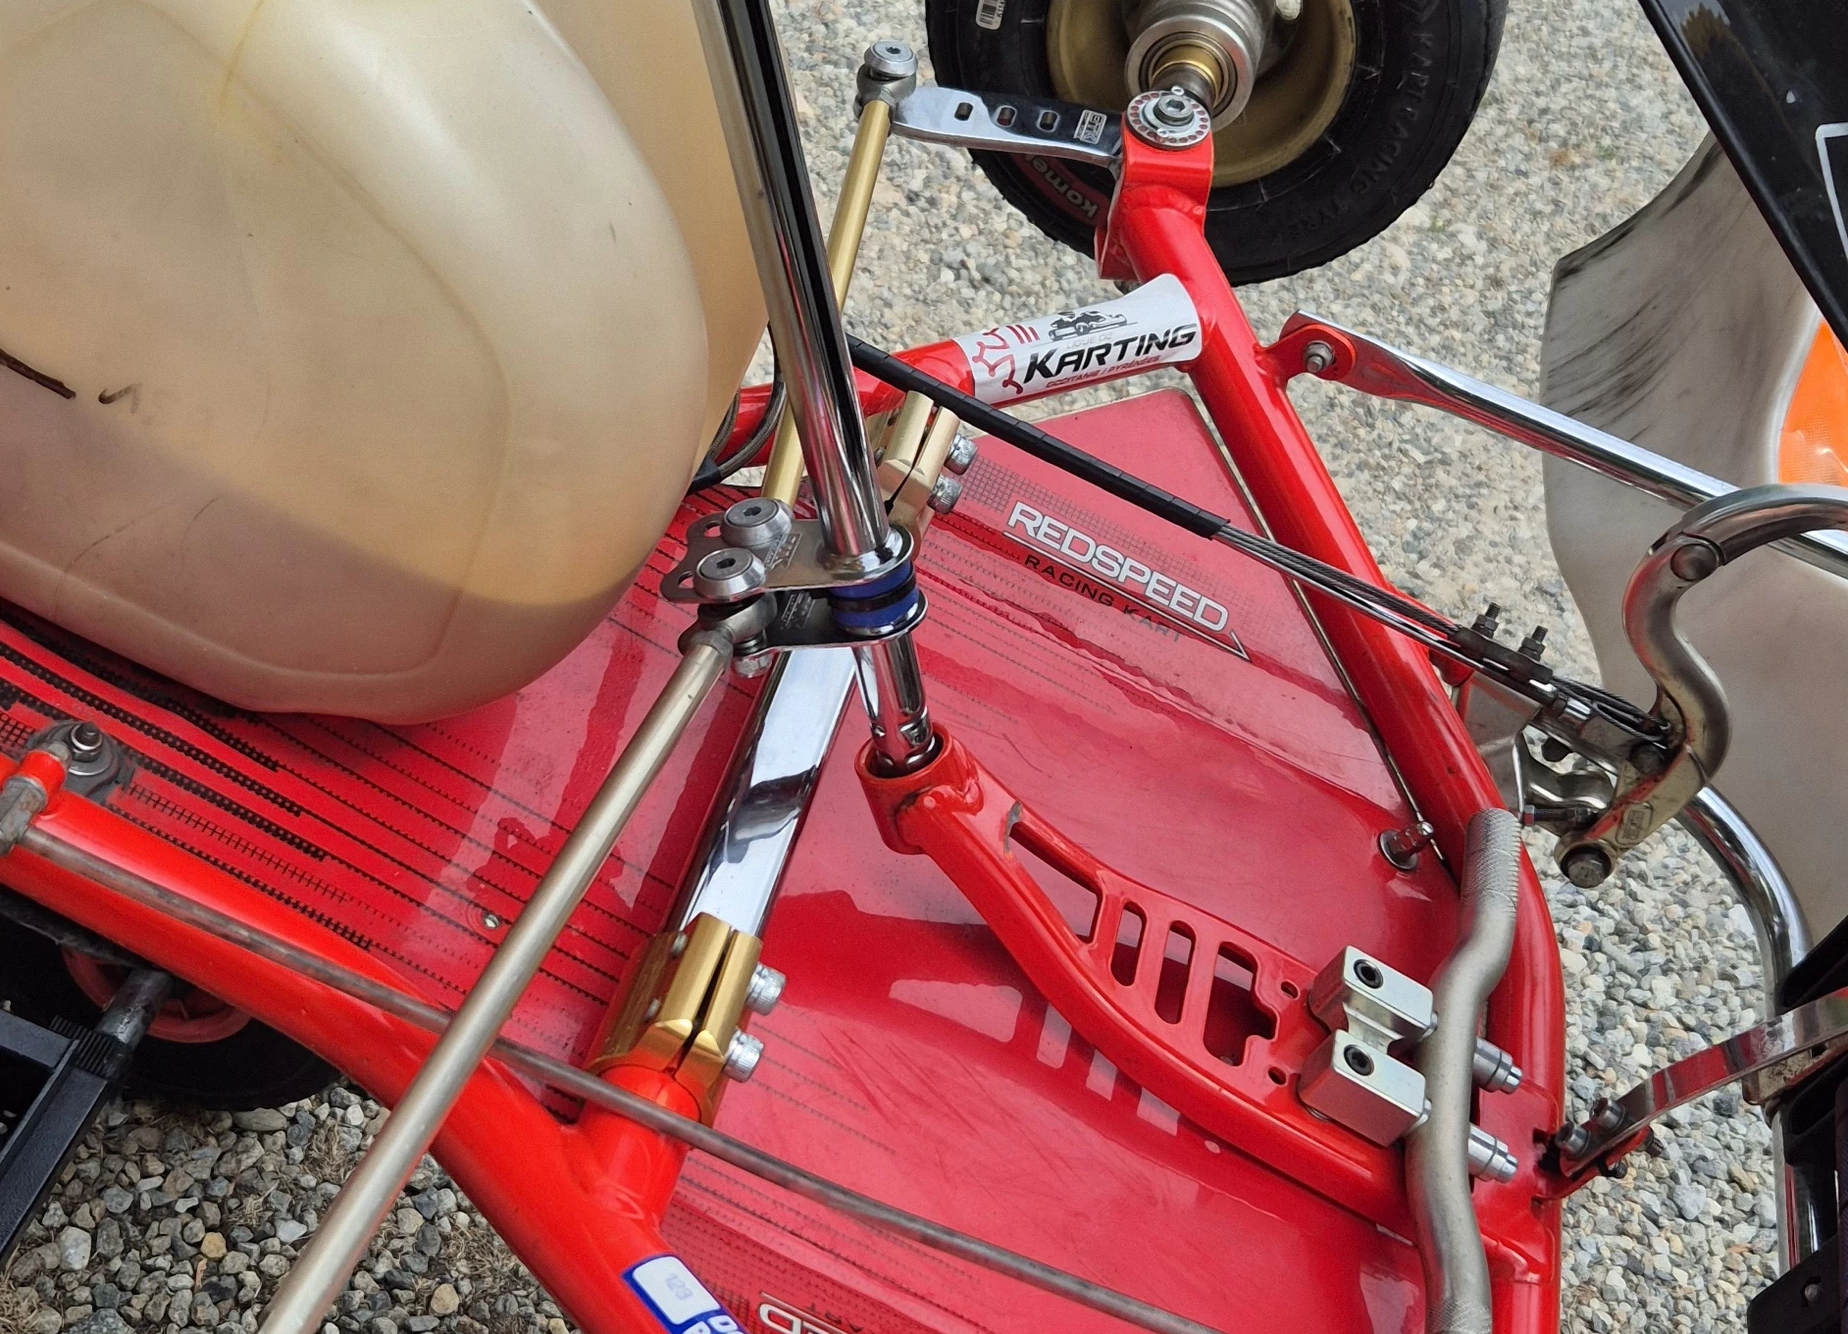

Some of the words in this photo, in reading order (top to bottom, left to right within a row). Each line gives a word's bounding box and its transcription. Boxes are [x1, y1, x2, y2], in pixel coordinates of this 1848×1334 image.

[1023, 323, 1198, 384] KARTING
[1007, 501, 1229, 633] REDSPEED
[1024, 553, 1114, 607] RACING
[1122, 604, 1182, 643] KART
